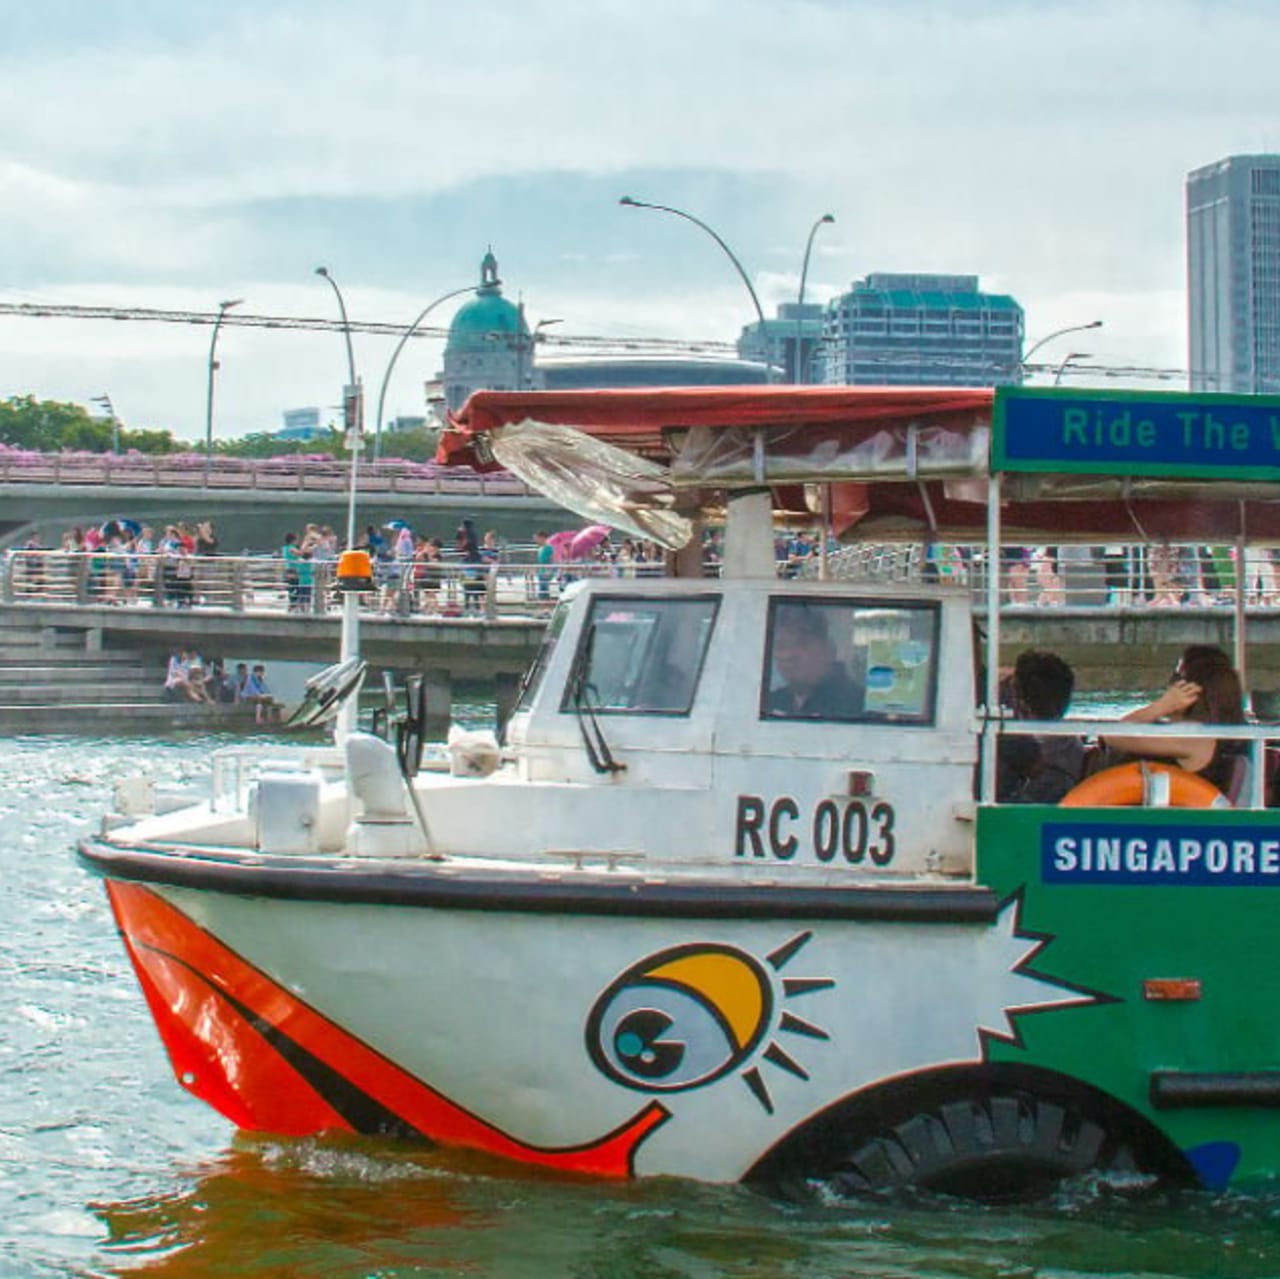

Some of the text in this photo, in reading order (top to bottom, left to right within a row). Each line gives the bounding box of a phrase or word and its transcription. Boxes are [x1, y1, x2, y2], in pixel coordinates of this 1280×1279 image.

[1063, 407, 1158, 448] Ride
[1176, 411, 1250, 451] The
[736, 795, 895, 866] RC 003
[1053, 837, 1280, 874] SINGAPORE
